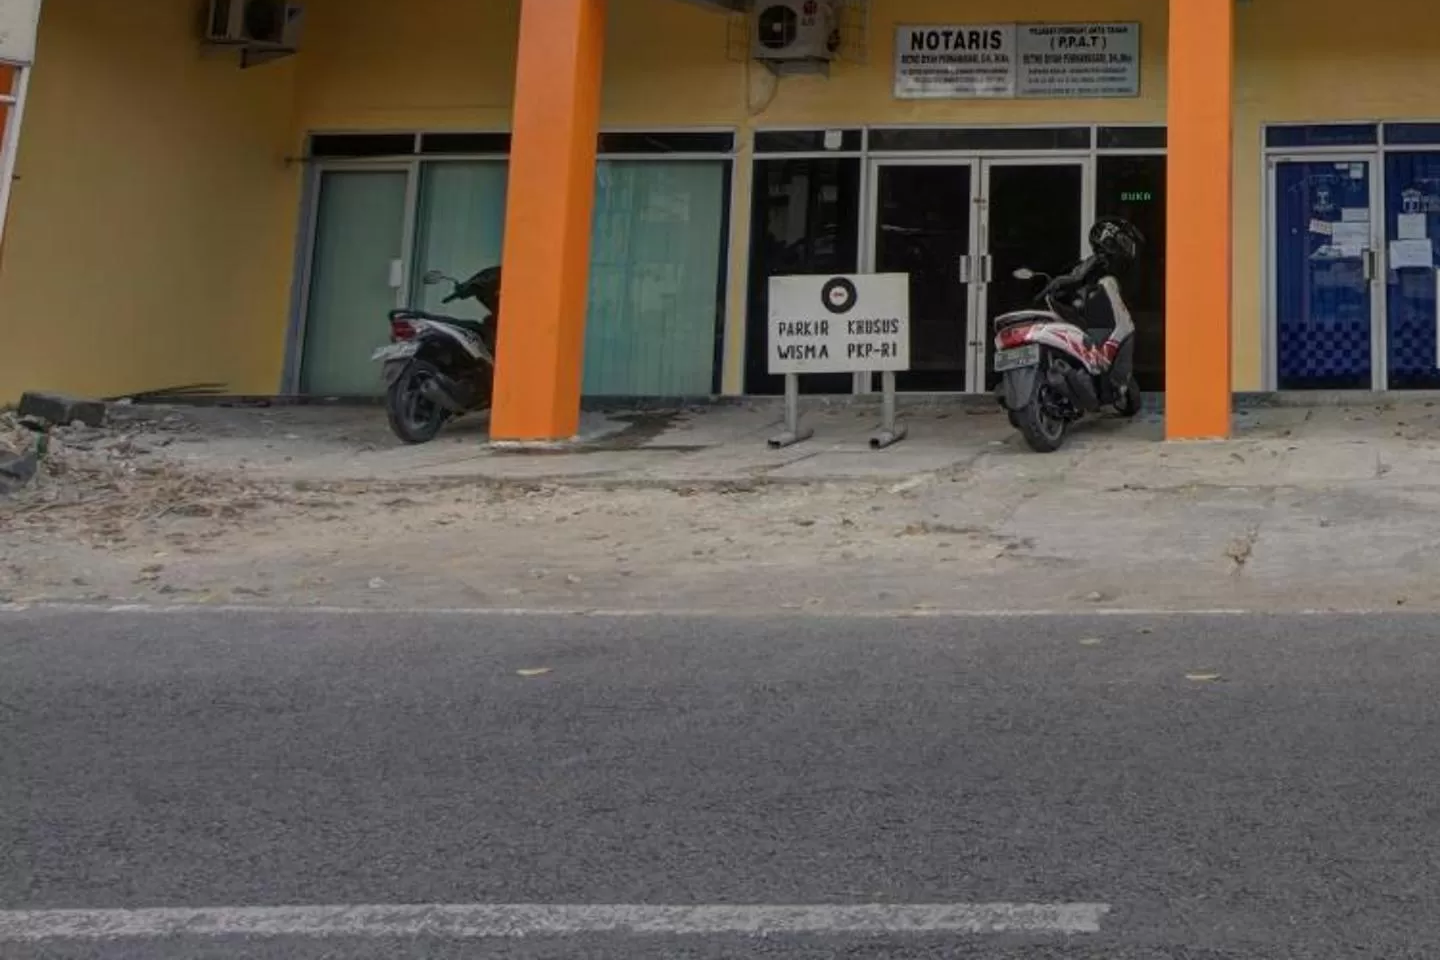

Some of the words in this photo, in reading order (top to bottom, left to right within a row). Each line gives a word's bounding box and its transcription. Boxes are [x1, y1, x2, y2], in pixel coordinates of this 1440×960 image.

[911, 29, 1002, 50] NOTARIS
[778, 319, 829, 336] PARKIR
[847, 318, 899, 335] KHUSUS
[777, 344, 829, 360] WISMA
[847, 342, 898, 359] PKP-RI
